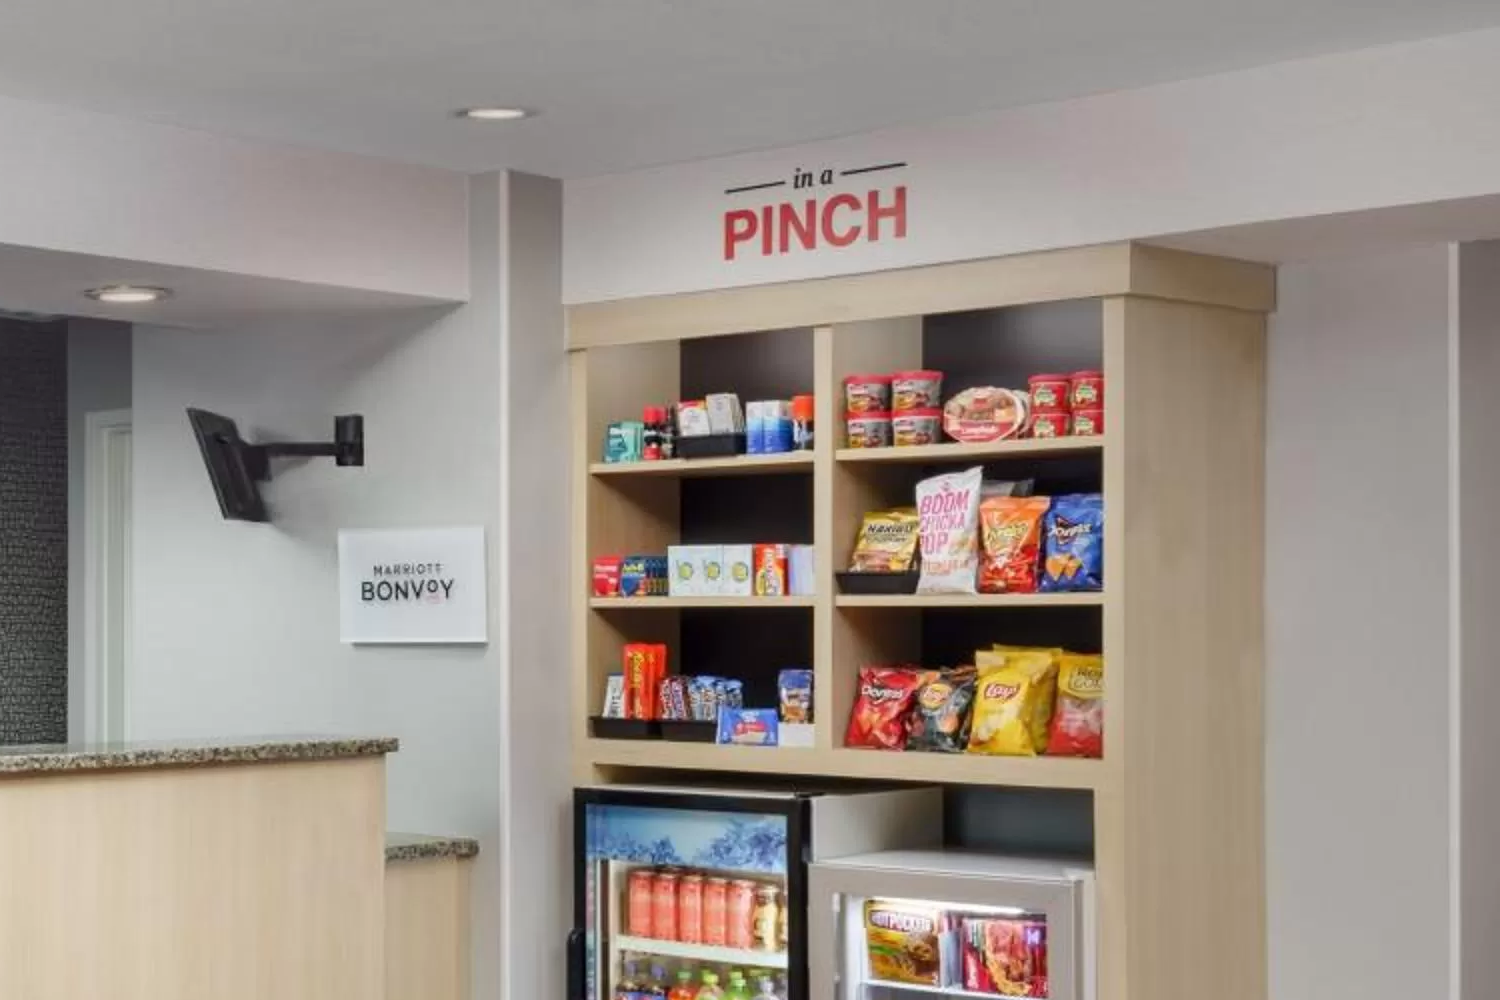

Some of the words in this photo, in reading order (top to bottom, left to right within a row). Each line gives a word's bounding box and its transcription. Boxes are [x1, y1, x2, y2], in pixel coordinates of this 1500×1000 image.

[793, 168, 813, 189] in
[820, 169, 833, 185] a
[724, 186, 907, 260] PINCH
[921, 489, 970, 515] BOOM
[373, 563, 443, 577] MARRIOTT
[361, 579, 454, 601] BONVOY
